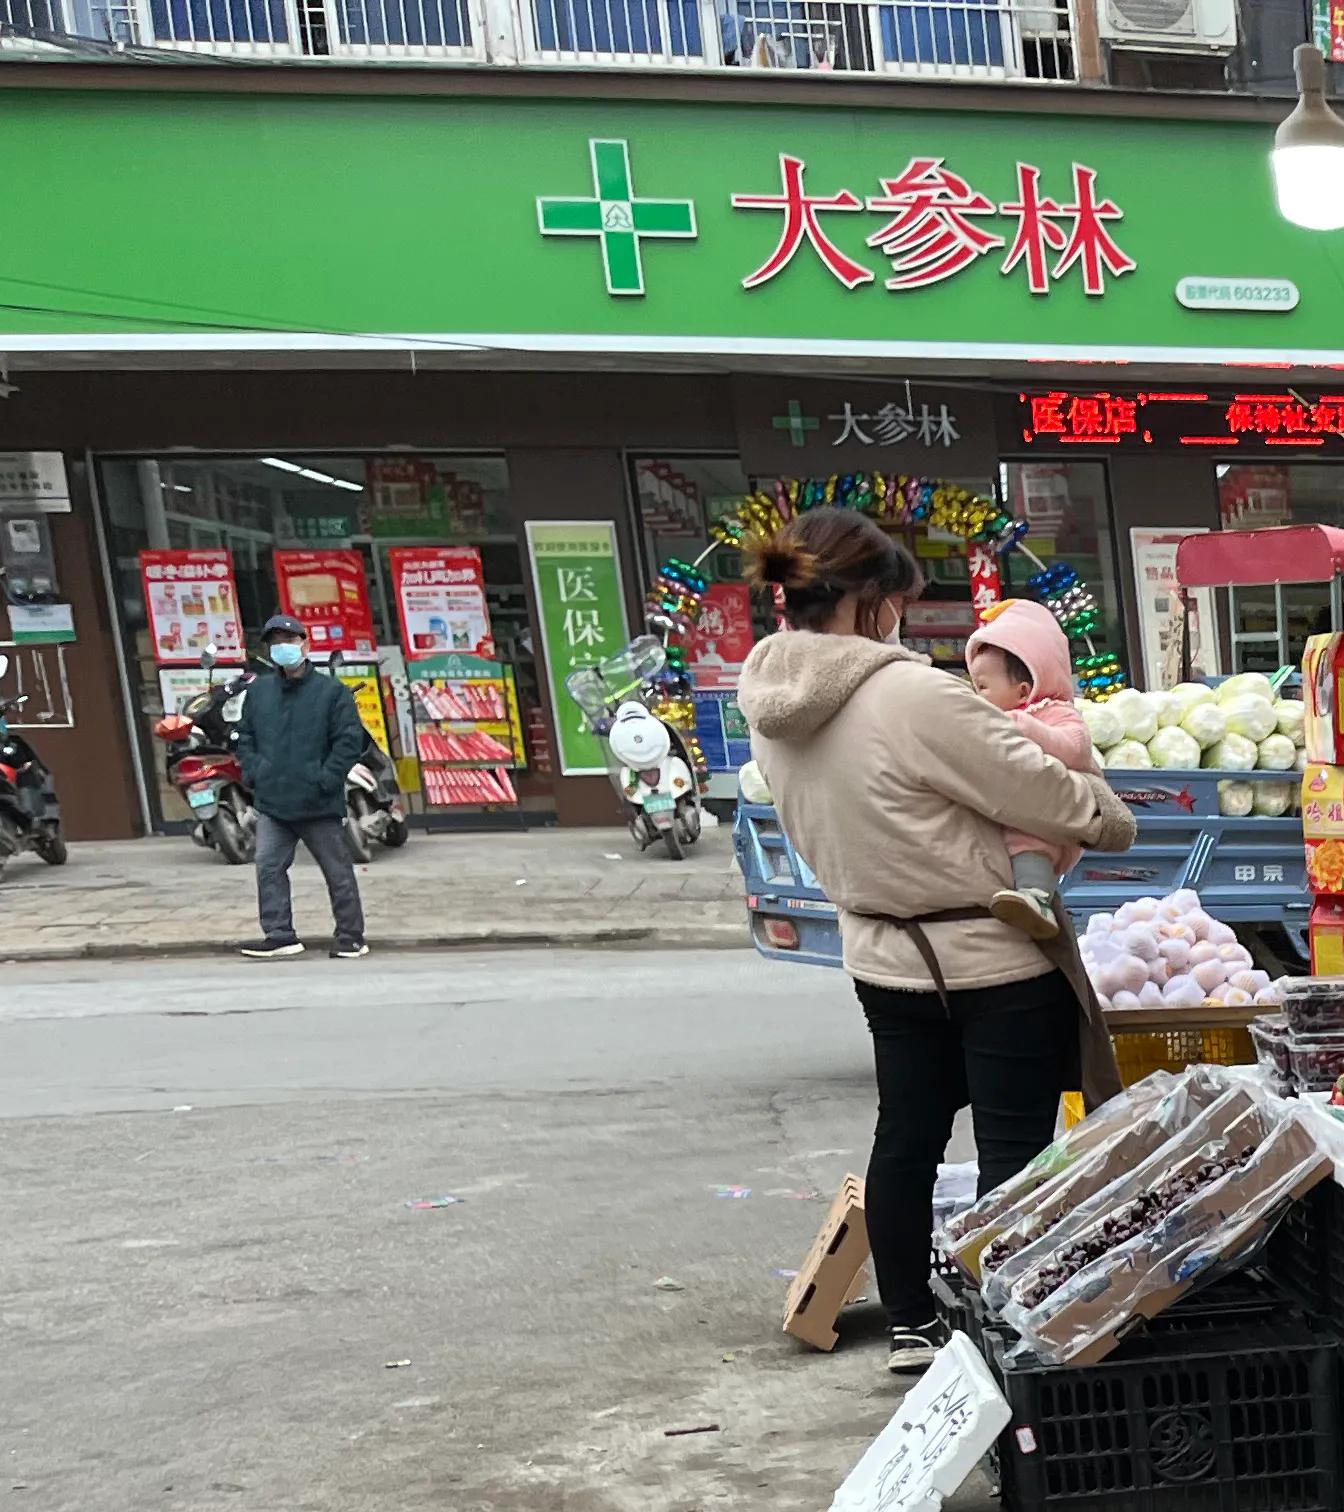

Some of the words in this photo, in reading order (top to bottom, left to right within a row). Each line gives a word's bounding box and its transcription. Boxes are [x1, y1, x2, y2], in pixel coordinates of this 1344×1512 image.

[731, 152, 1137, 297] 大参林
[1233, 286, 1291, 302] 603233
[827, 401, 961, 447] 大参林
[1031, 396, 1137, 434] 医保店
